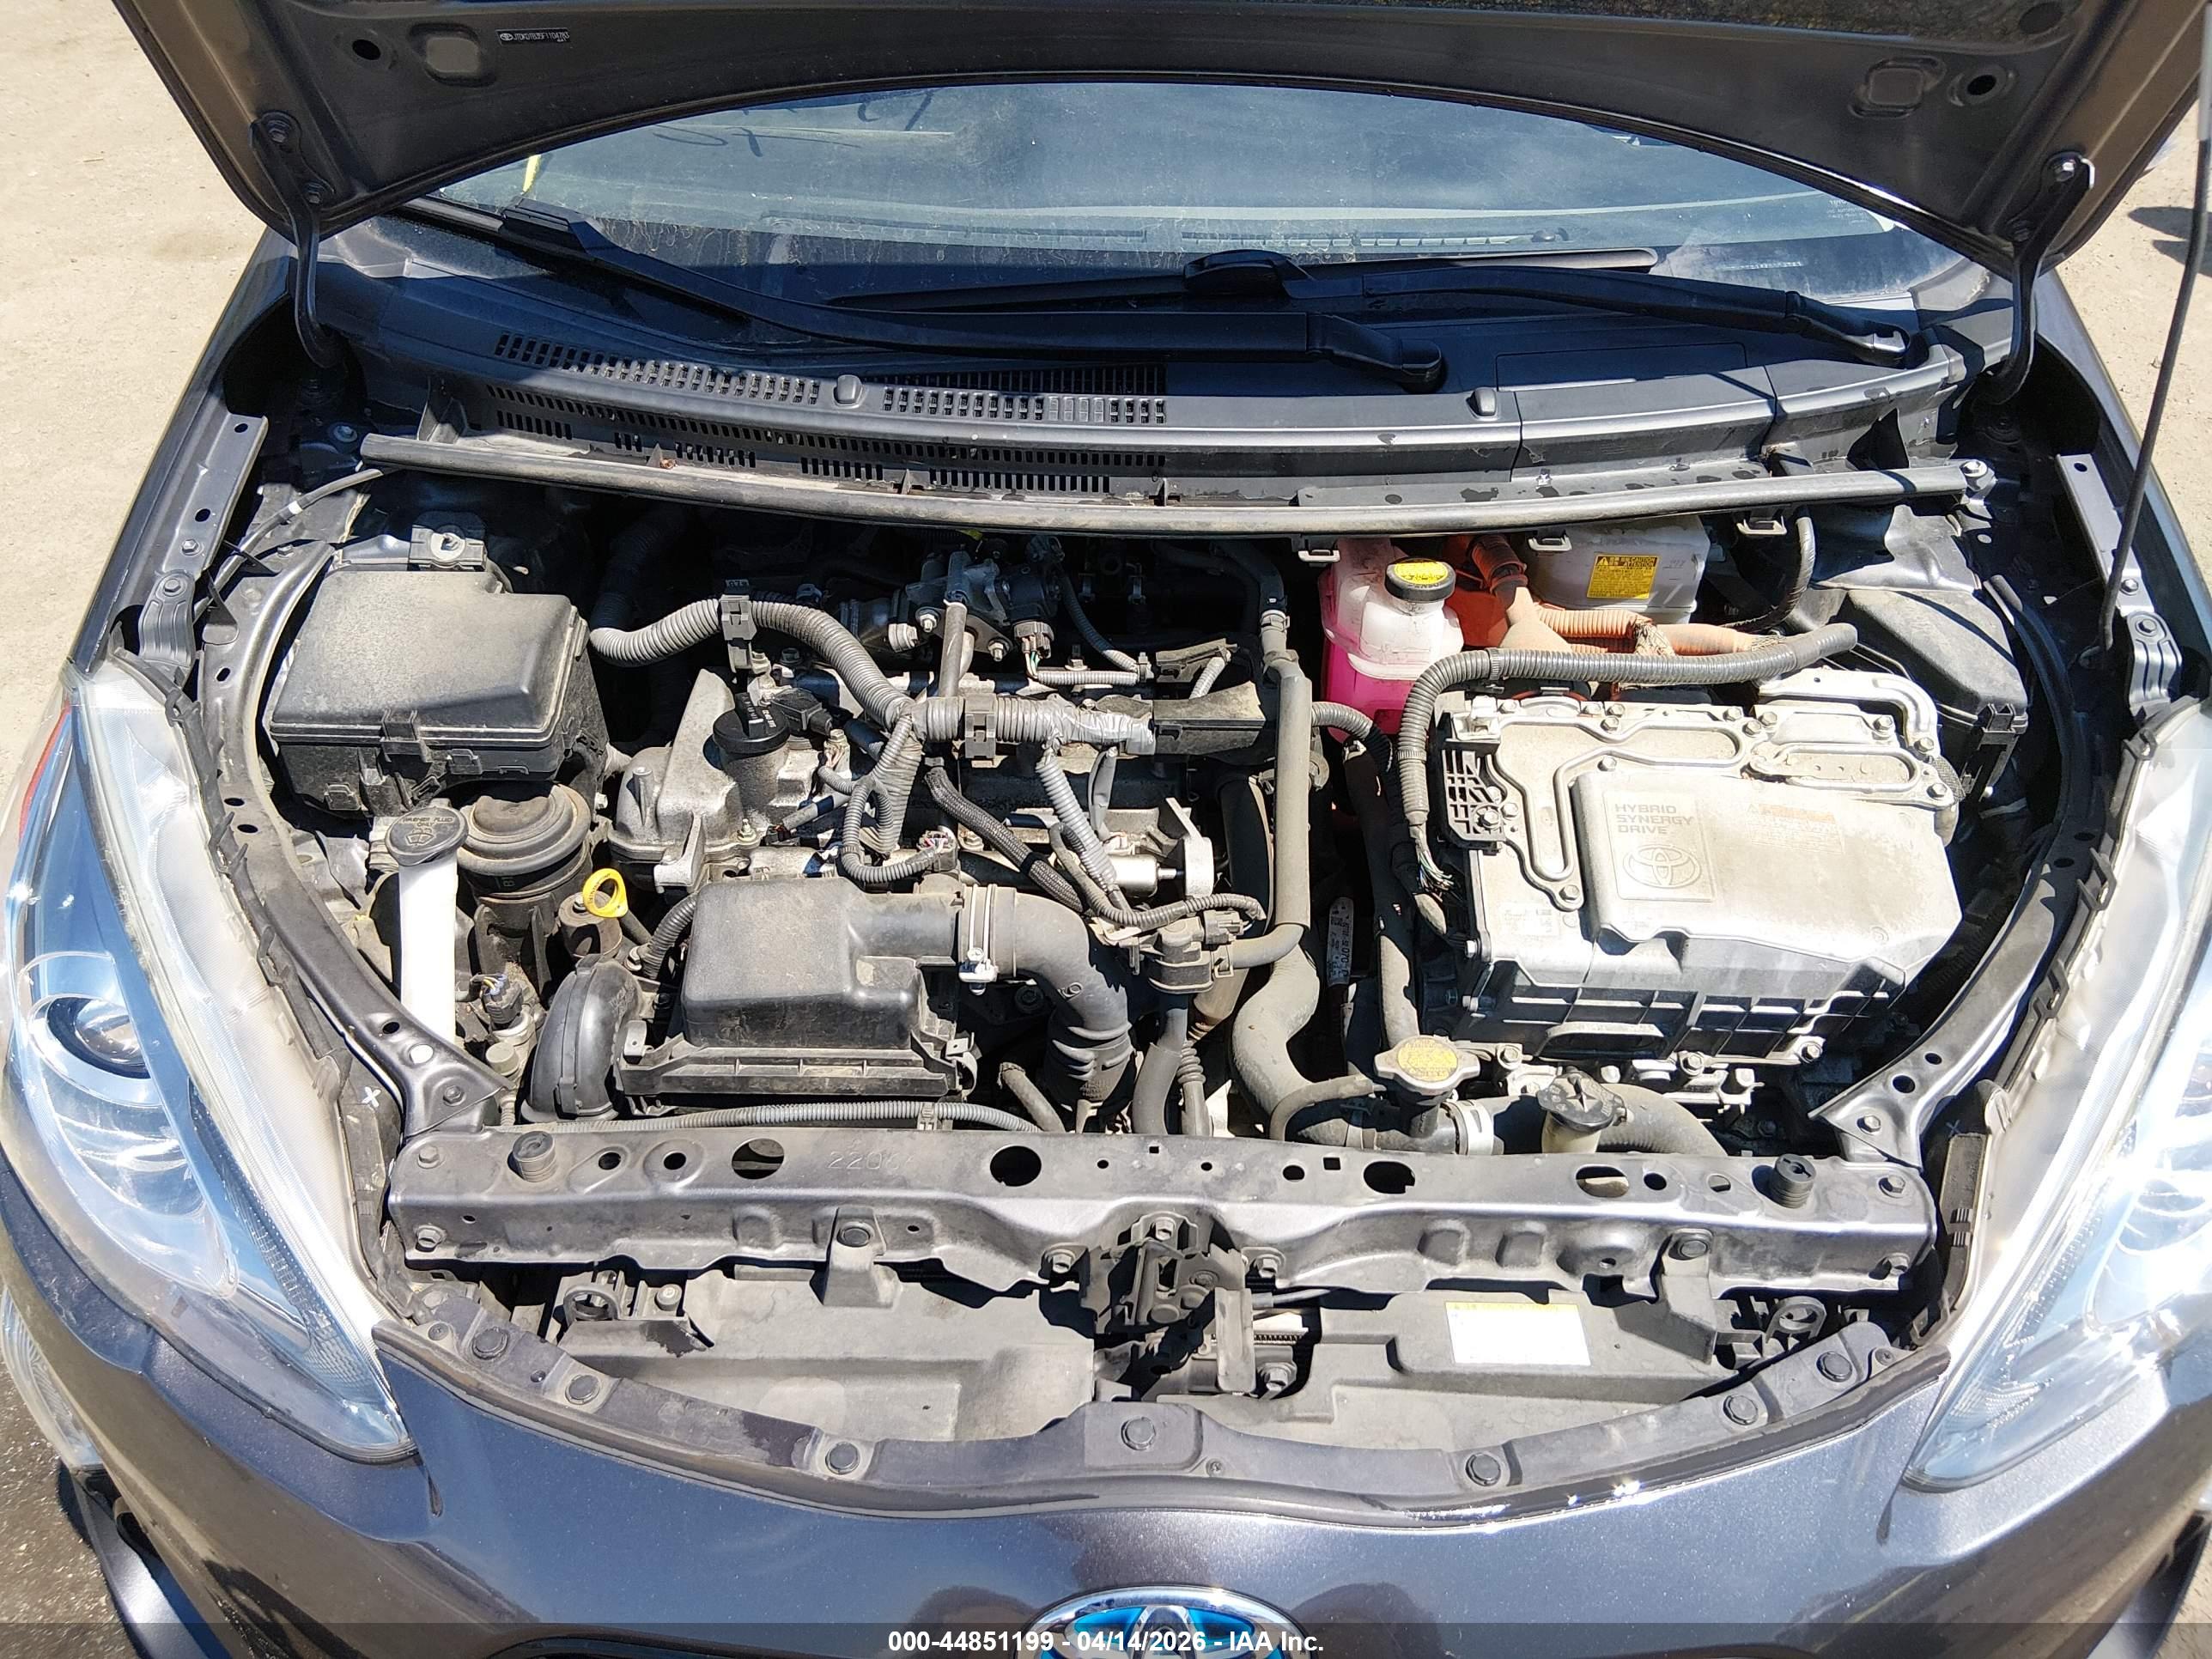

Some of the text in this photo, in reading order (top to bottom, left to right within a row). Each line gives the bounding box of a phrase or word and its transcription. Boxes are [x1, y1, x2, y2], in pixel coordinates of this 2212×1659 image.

[1614, 803, 1677, 814] HYBRID
[1615, 814, 1695, 825] SYNERGY
[1617, 824, 1669, 835] DRIVE
